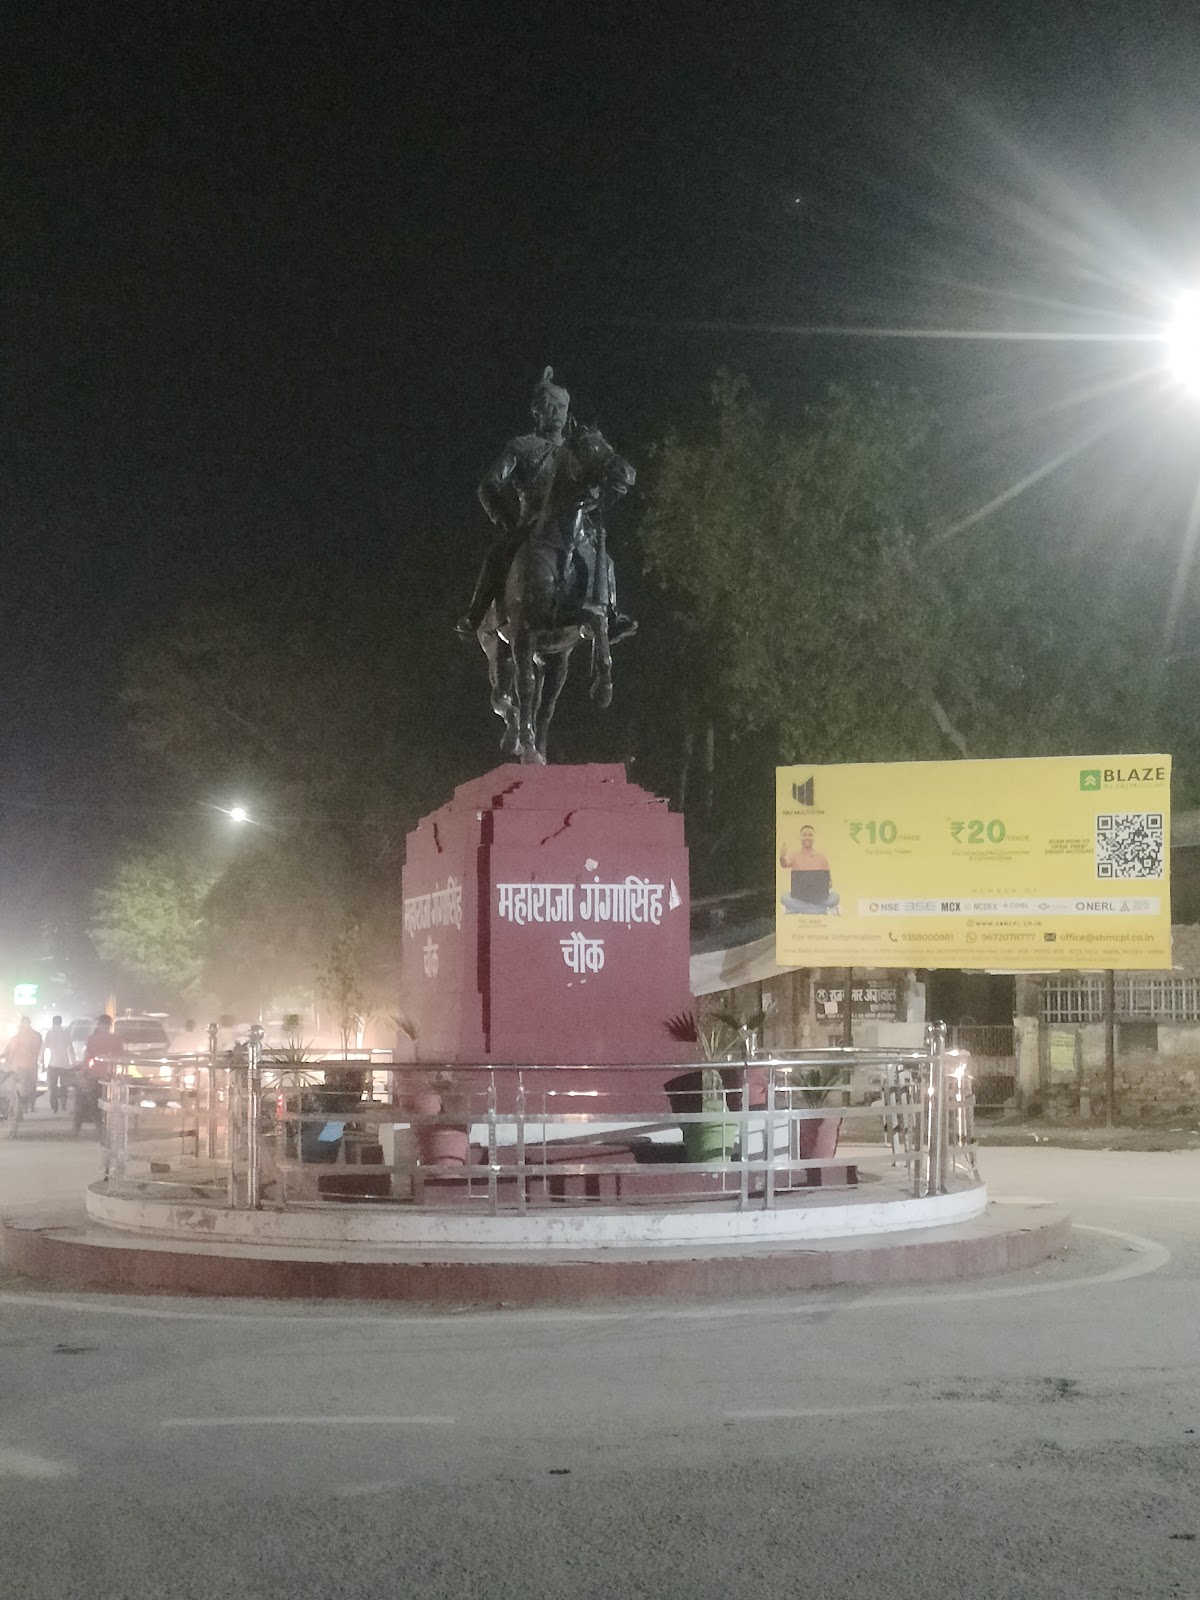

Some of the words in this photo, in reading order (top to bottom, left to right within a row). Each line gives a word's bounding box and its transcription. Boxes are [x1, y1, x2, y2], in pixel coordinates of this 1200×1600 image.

[1103, 767, 1165, 782] BLAZE
[496, 883, 575, 925] महाराजा
[580, 875, 665, 925] गंगासिंह
[880, 903, 899, 912] NSE
[941, 902, 961, 912] MCX
[1060, 932, 1154, 943] office@sbmcpl.co.in
[559, 931, 605, 974] चौक
